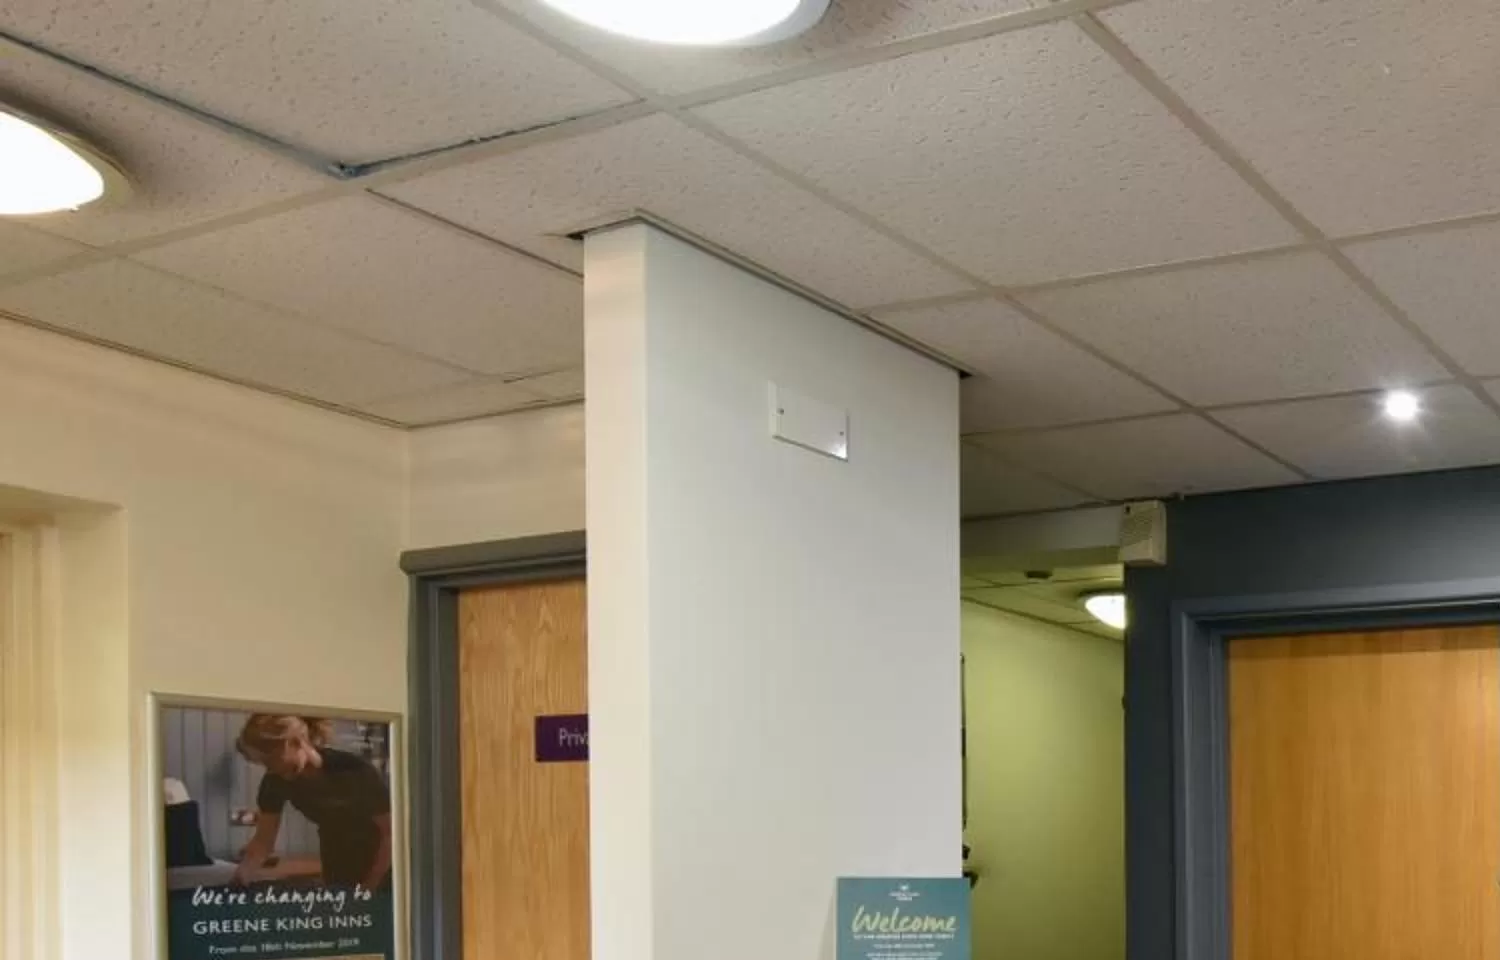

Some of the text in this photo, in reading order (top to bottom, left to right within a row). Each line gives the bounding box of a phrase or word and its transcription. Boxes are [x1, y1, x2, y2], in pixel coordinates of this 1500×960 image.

[559, 727, 588, 746] Priv
[192, 883, 372, 913] We're changing to
[193, 914, 372, 935] GREENE KING INNS
[852, 905, 956, 932] Welcome
